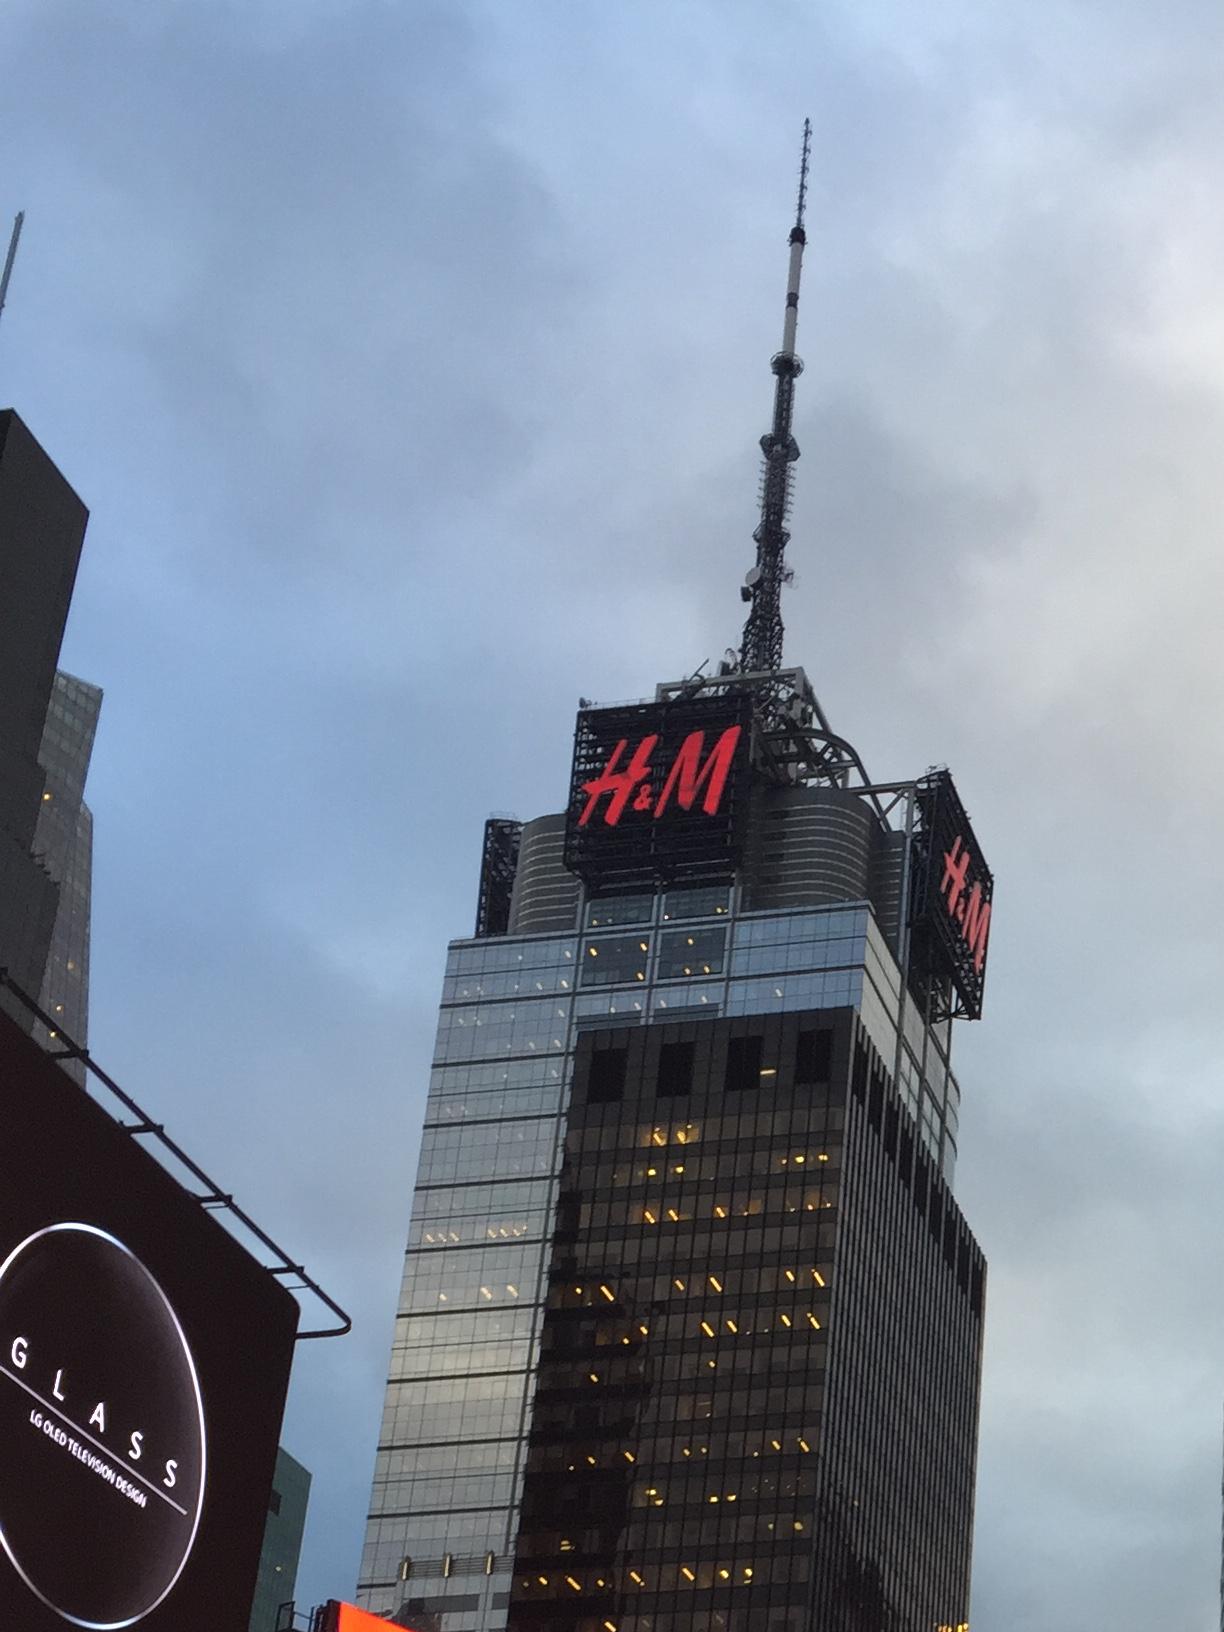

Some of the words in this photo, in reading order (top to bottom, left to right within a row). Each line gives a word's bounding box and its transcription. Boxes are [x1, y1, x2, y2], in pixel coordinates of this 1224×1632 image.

[577, 724, 742, 827] H&M
[939, 836, 992, 973] H&M
[12, 1336, 177, 1488] GLASS
[29, 1409, 42, 1428] LG
[42, 1420, 67, 1446] OLED
[67, 1438, 116, 1484] TELEVISION
[115, 1475, 148, 1508] DESIGN
